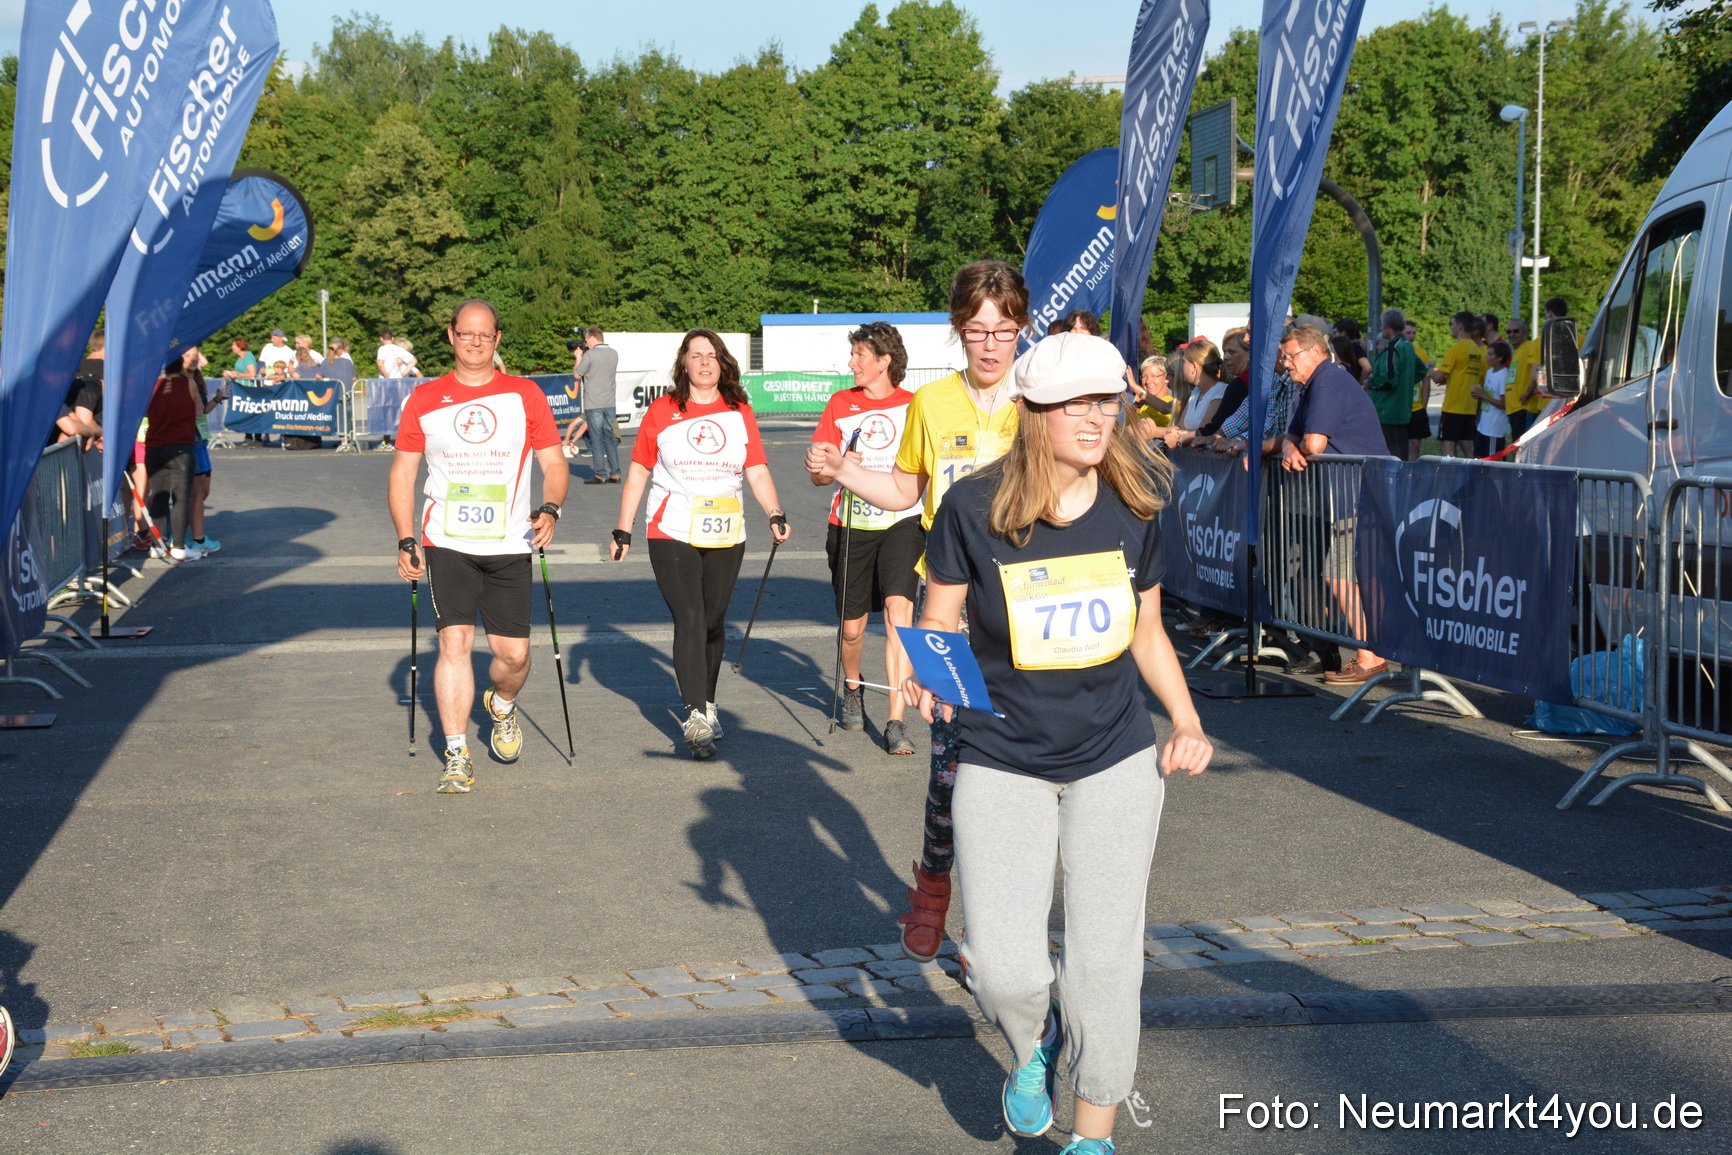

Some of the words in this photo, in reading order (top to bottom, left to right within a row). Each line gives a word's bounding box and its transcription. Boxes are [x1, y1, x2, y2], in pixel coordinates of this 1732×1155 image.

[71, 0, 157, 161] Fisc
[120, 0, 186, 157] AUTOMO
[1285, 0, 1333, 150] Fisc
[1311, 0, 1350, 143] AUTOMO
[148, 5, 237, 220] Fischer
[181, 45, 250, 217] AUTOMOBILE
[216, 274, 247, 299] Druck
[246, 264, 265, 279] und
[266, 235, 303, 268] Medien
[1019, 226, 1115, 348] Frischmann
[1085, 261, 1110, 291] Druck
[231, 395, 309, 414] Frischmann
[763, 380, 833, 392] GESUNDHEIT
[780, 393, 802, 402] BESTEN
[275, 411, 294, 420] Druck
[294, 412, 306, 421] und
[307, 412, 333, 422] Medien
[490, 450, 511, 458] HERZ
[458, 506, 494, 524] 530
[701, 517, 731, 533] 531
[1186, 512, 1241, 563] Fischer
[1023, 576, 1066, 590] firmenlauf
[1413, 551, 1527, 620] Fischer
[1034, 598, 1111, 640] 770
[1426, 617, 1520, 656] AUTOMOBILE
[1053, 645, 1083, 654] Claudia
[1083, 642, 1100, 651] Wolf
[943, 656, 971, 709] Lebenshilfe
